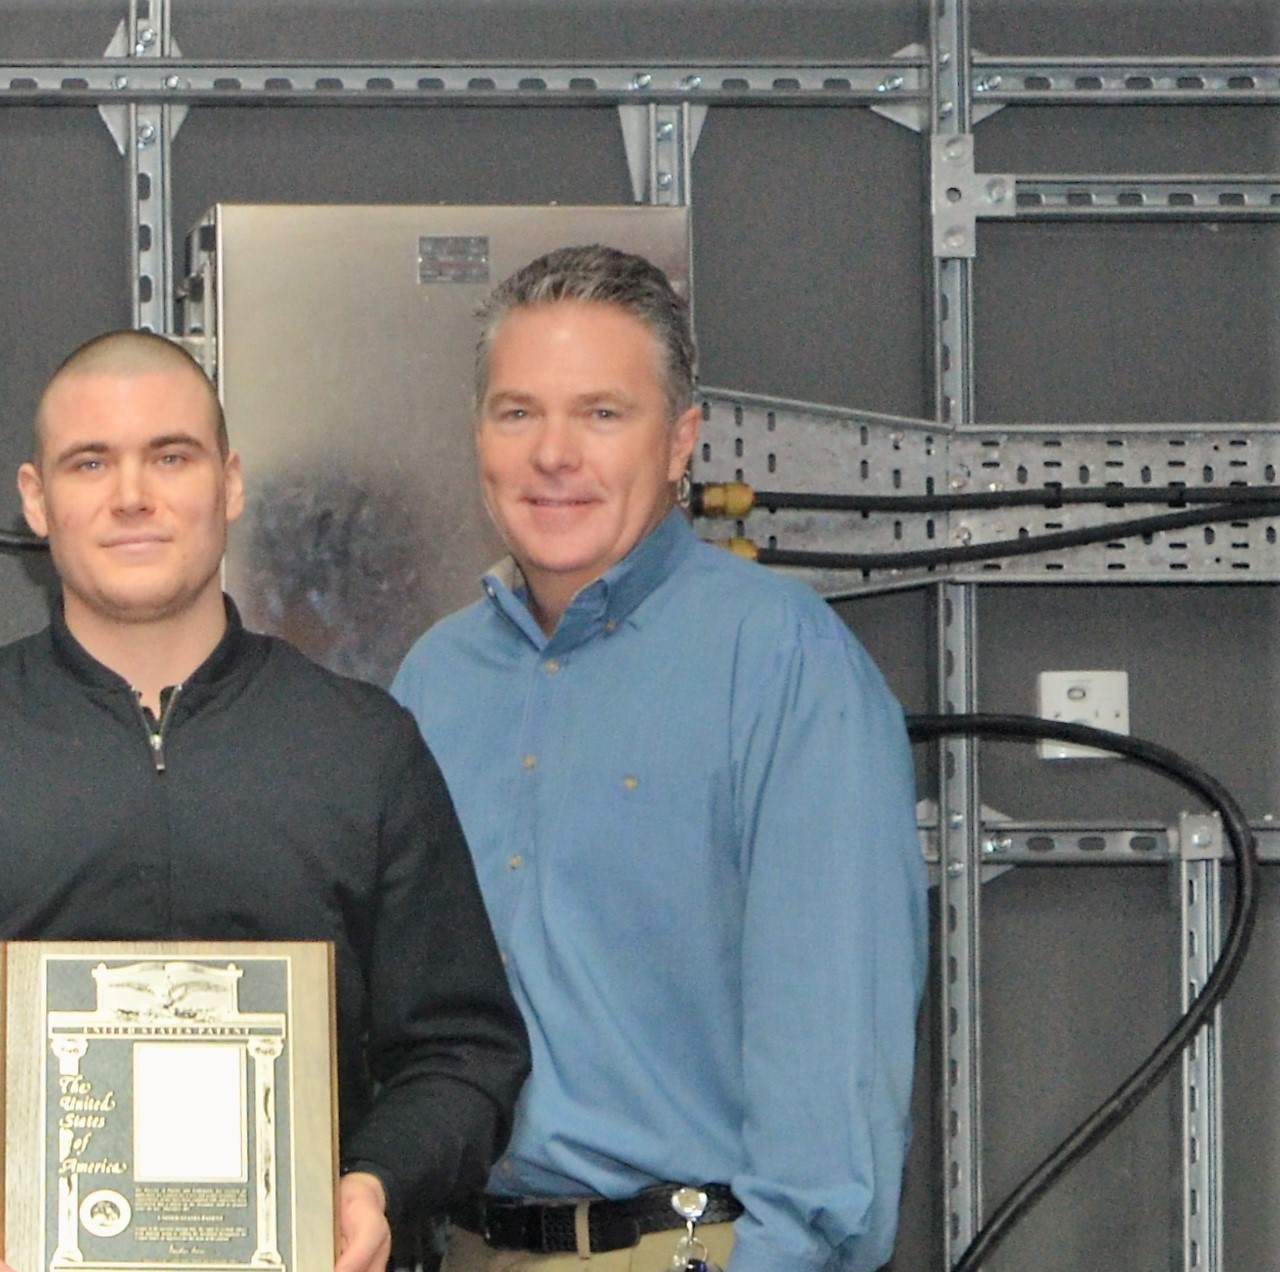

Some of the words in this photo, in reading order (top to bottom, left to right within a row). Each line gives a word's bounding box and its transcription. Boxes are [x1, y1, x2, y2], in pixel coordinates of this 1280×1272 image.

[59, 1074, 91, 1094] The
[59, 1091, 116, 1111] United
[59, 1112, 105, 1128] States
[73, 1132, 92, 1156] of
[58, 1158, 127, 1174] America
